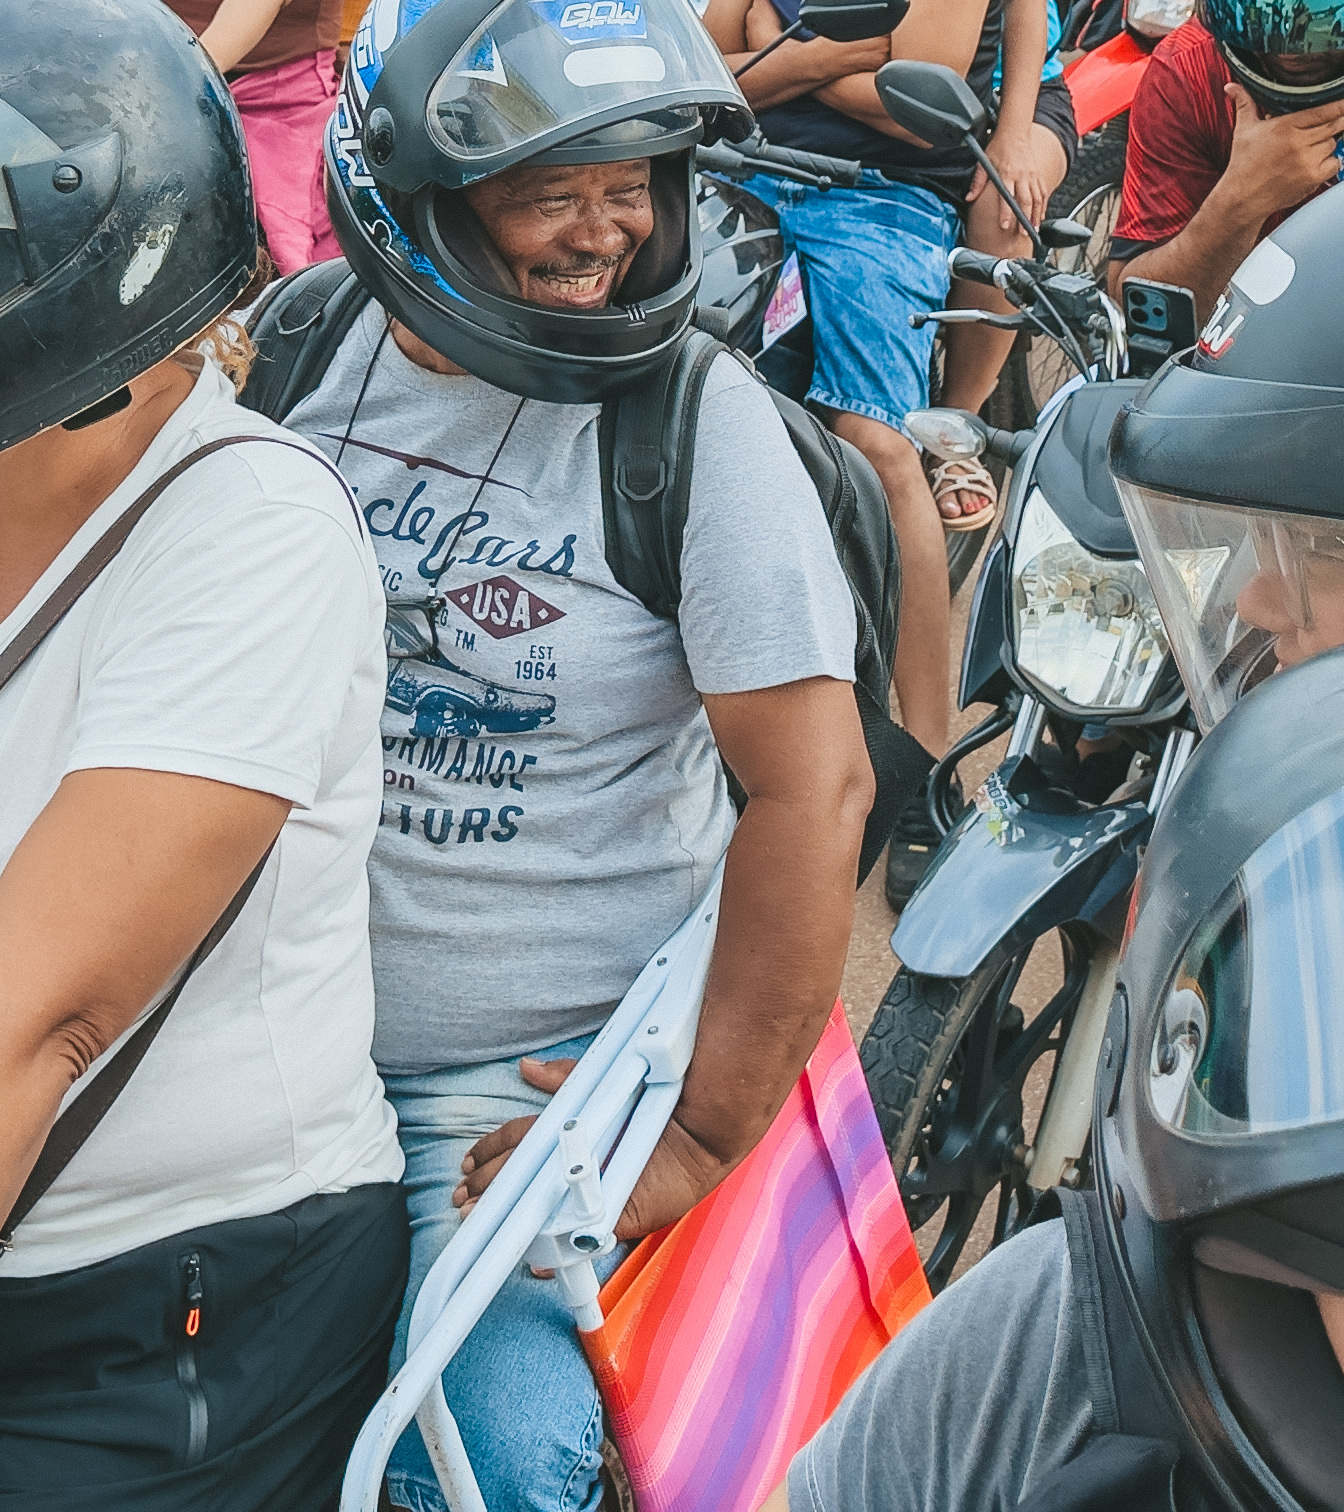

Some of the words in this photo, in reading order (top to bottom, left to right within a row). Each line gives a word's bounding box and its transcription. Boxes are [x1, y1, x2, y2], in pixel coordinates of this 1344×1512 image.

[559, 0, 641, 29] GOW
[417, 510, 578, 580] Cars
[471, 581, 532, 630] USA
[529, 644, 555, 661] EST
[514, 659, 559, 682] 1964
